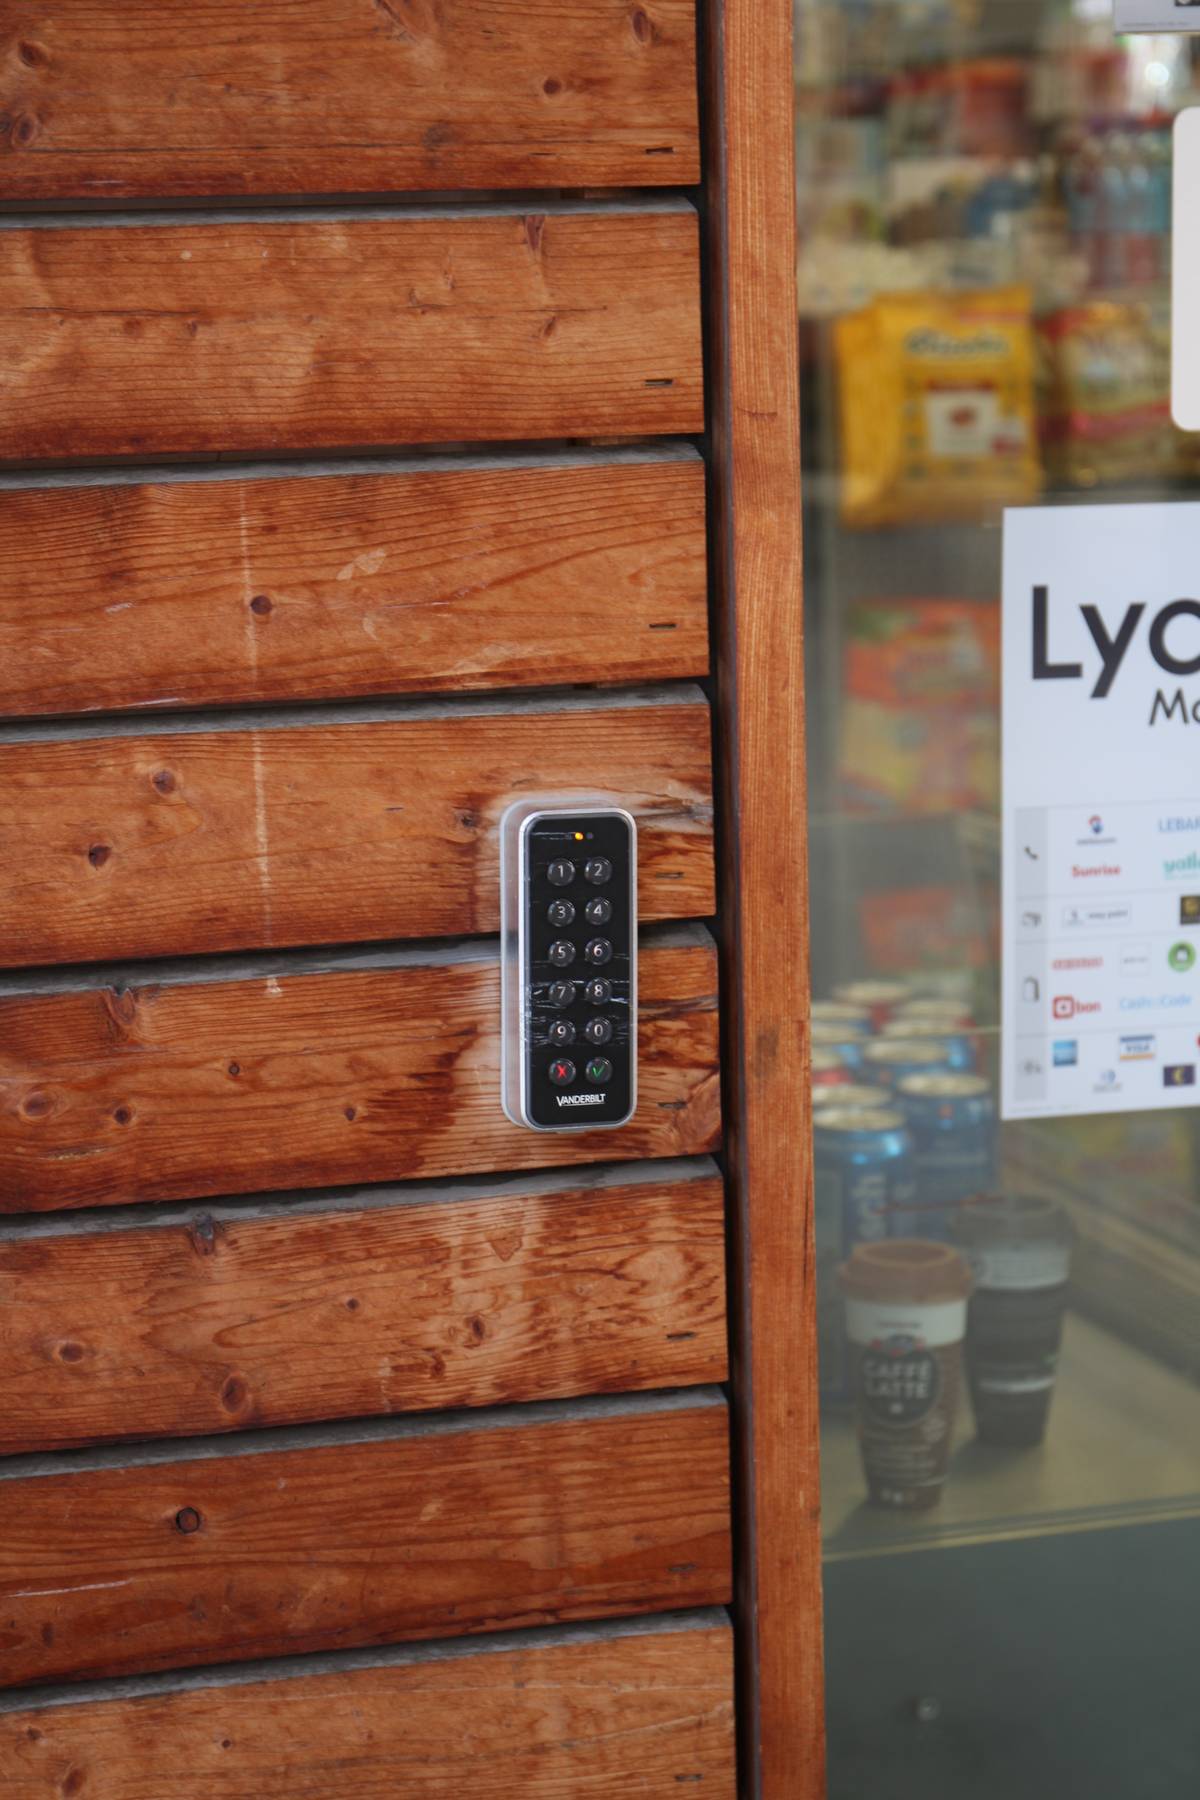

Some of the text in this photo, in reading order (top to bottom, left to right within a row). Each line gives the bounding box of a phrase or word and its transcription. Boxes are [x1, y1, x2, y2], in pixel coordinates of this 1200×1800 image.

[558, 863, 603, 878] 1 2
[557, 904, 602, 919] 3 4
[557, 944, 602, 959] 5 6
[557, 984, 603, 999] 7 8
[557, 1024, 603, 1038] 9 0
[556, 1093, 606, 1107] VANDERBILT
